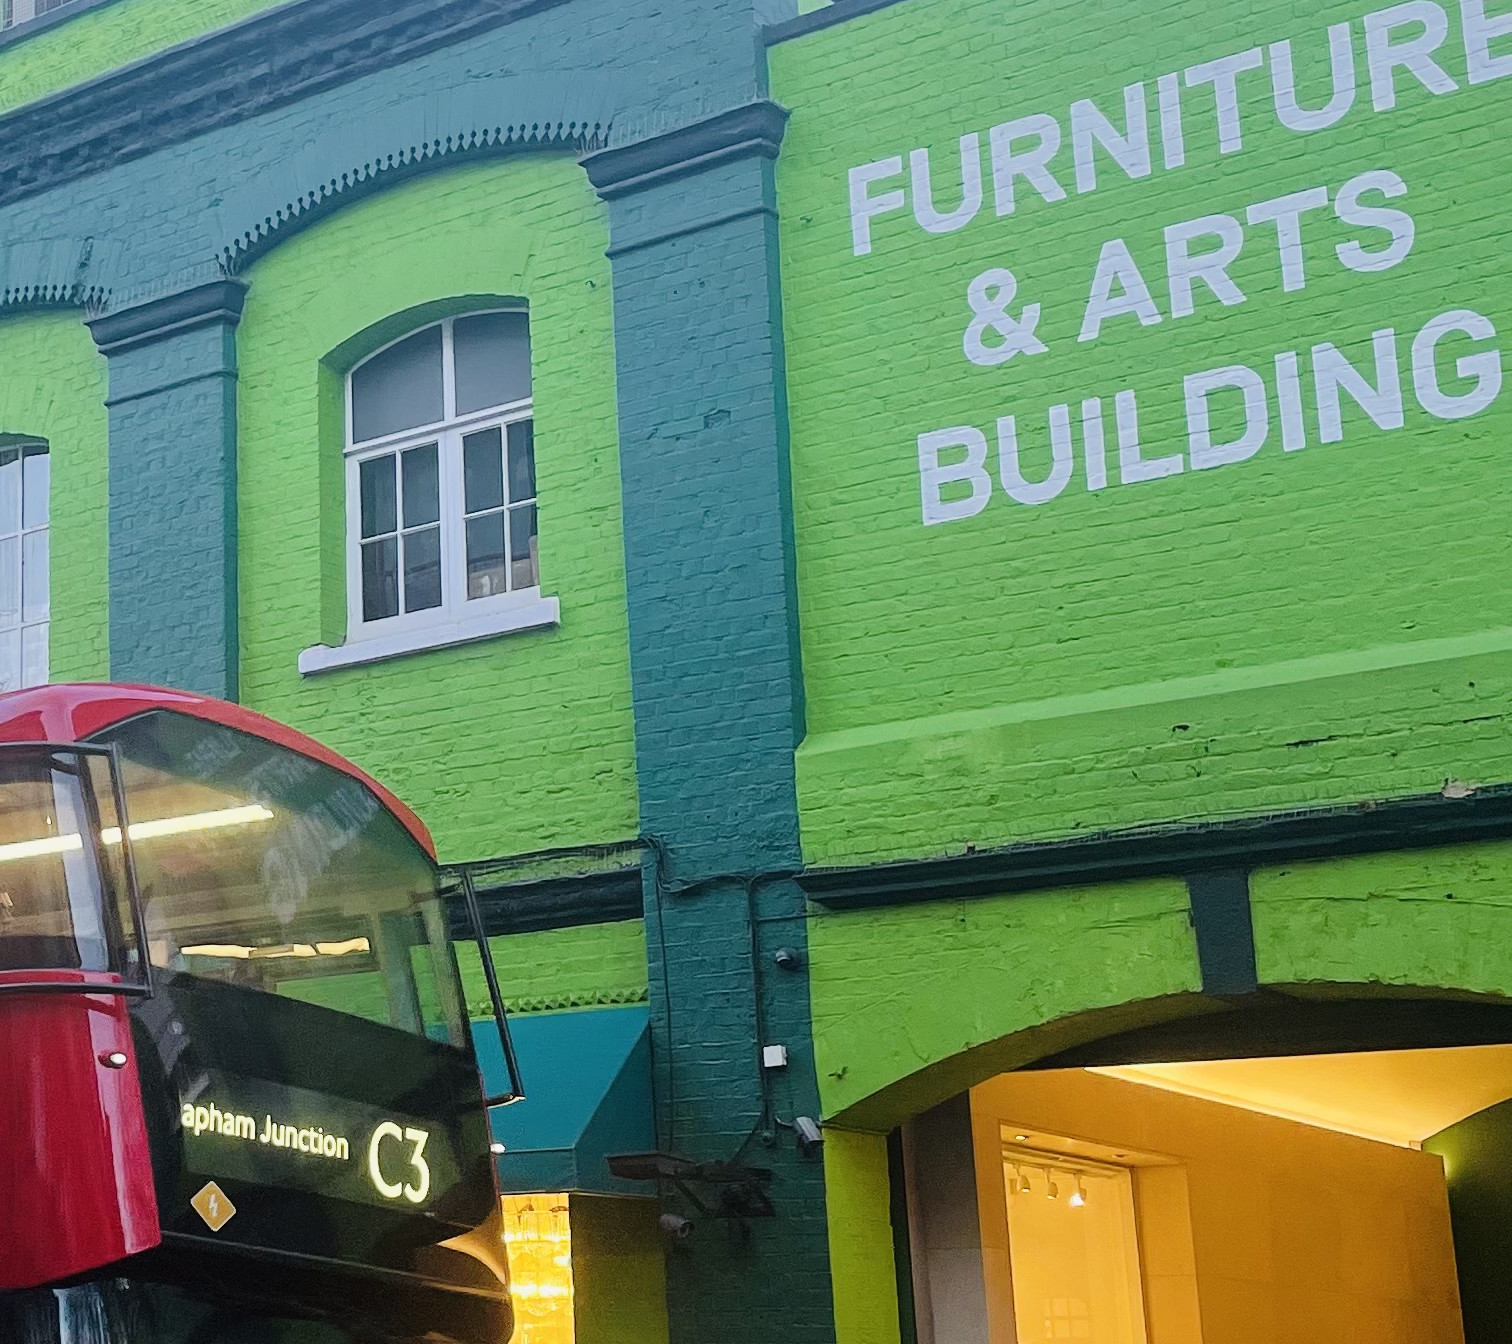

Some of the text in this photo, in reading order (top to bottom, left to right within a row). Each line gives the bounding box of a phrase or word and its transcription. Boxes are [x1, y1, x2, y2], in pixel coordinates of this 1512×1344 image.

[962, 168, 1416, 366] & ARTS
[917, 308, 1503, 525] BUILDING
[259, 1114, 350, 1160] Junction
[369, 1121, 430, 1203] C3
